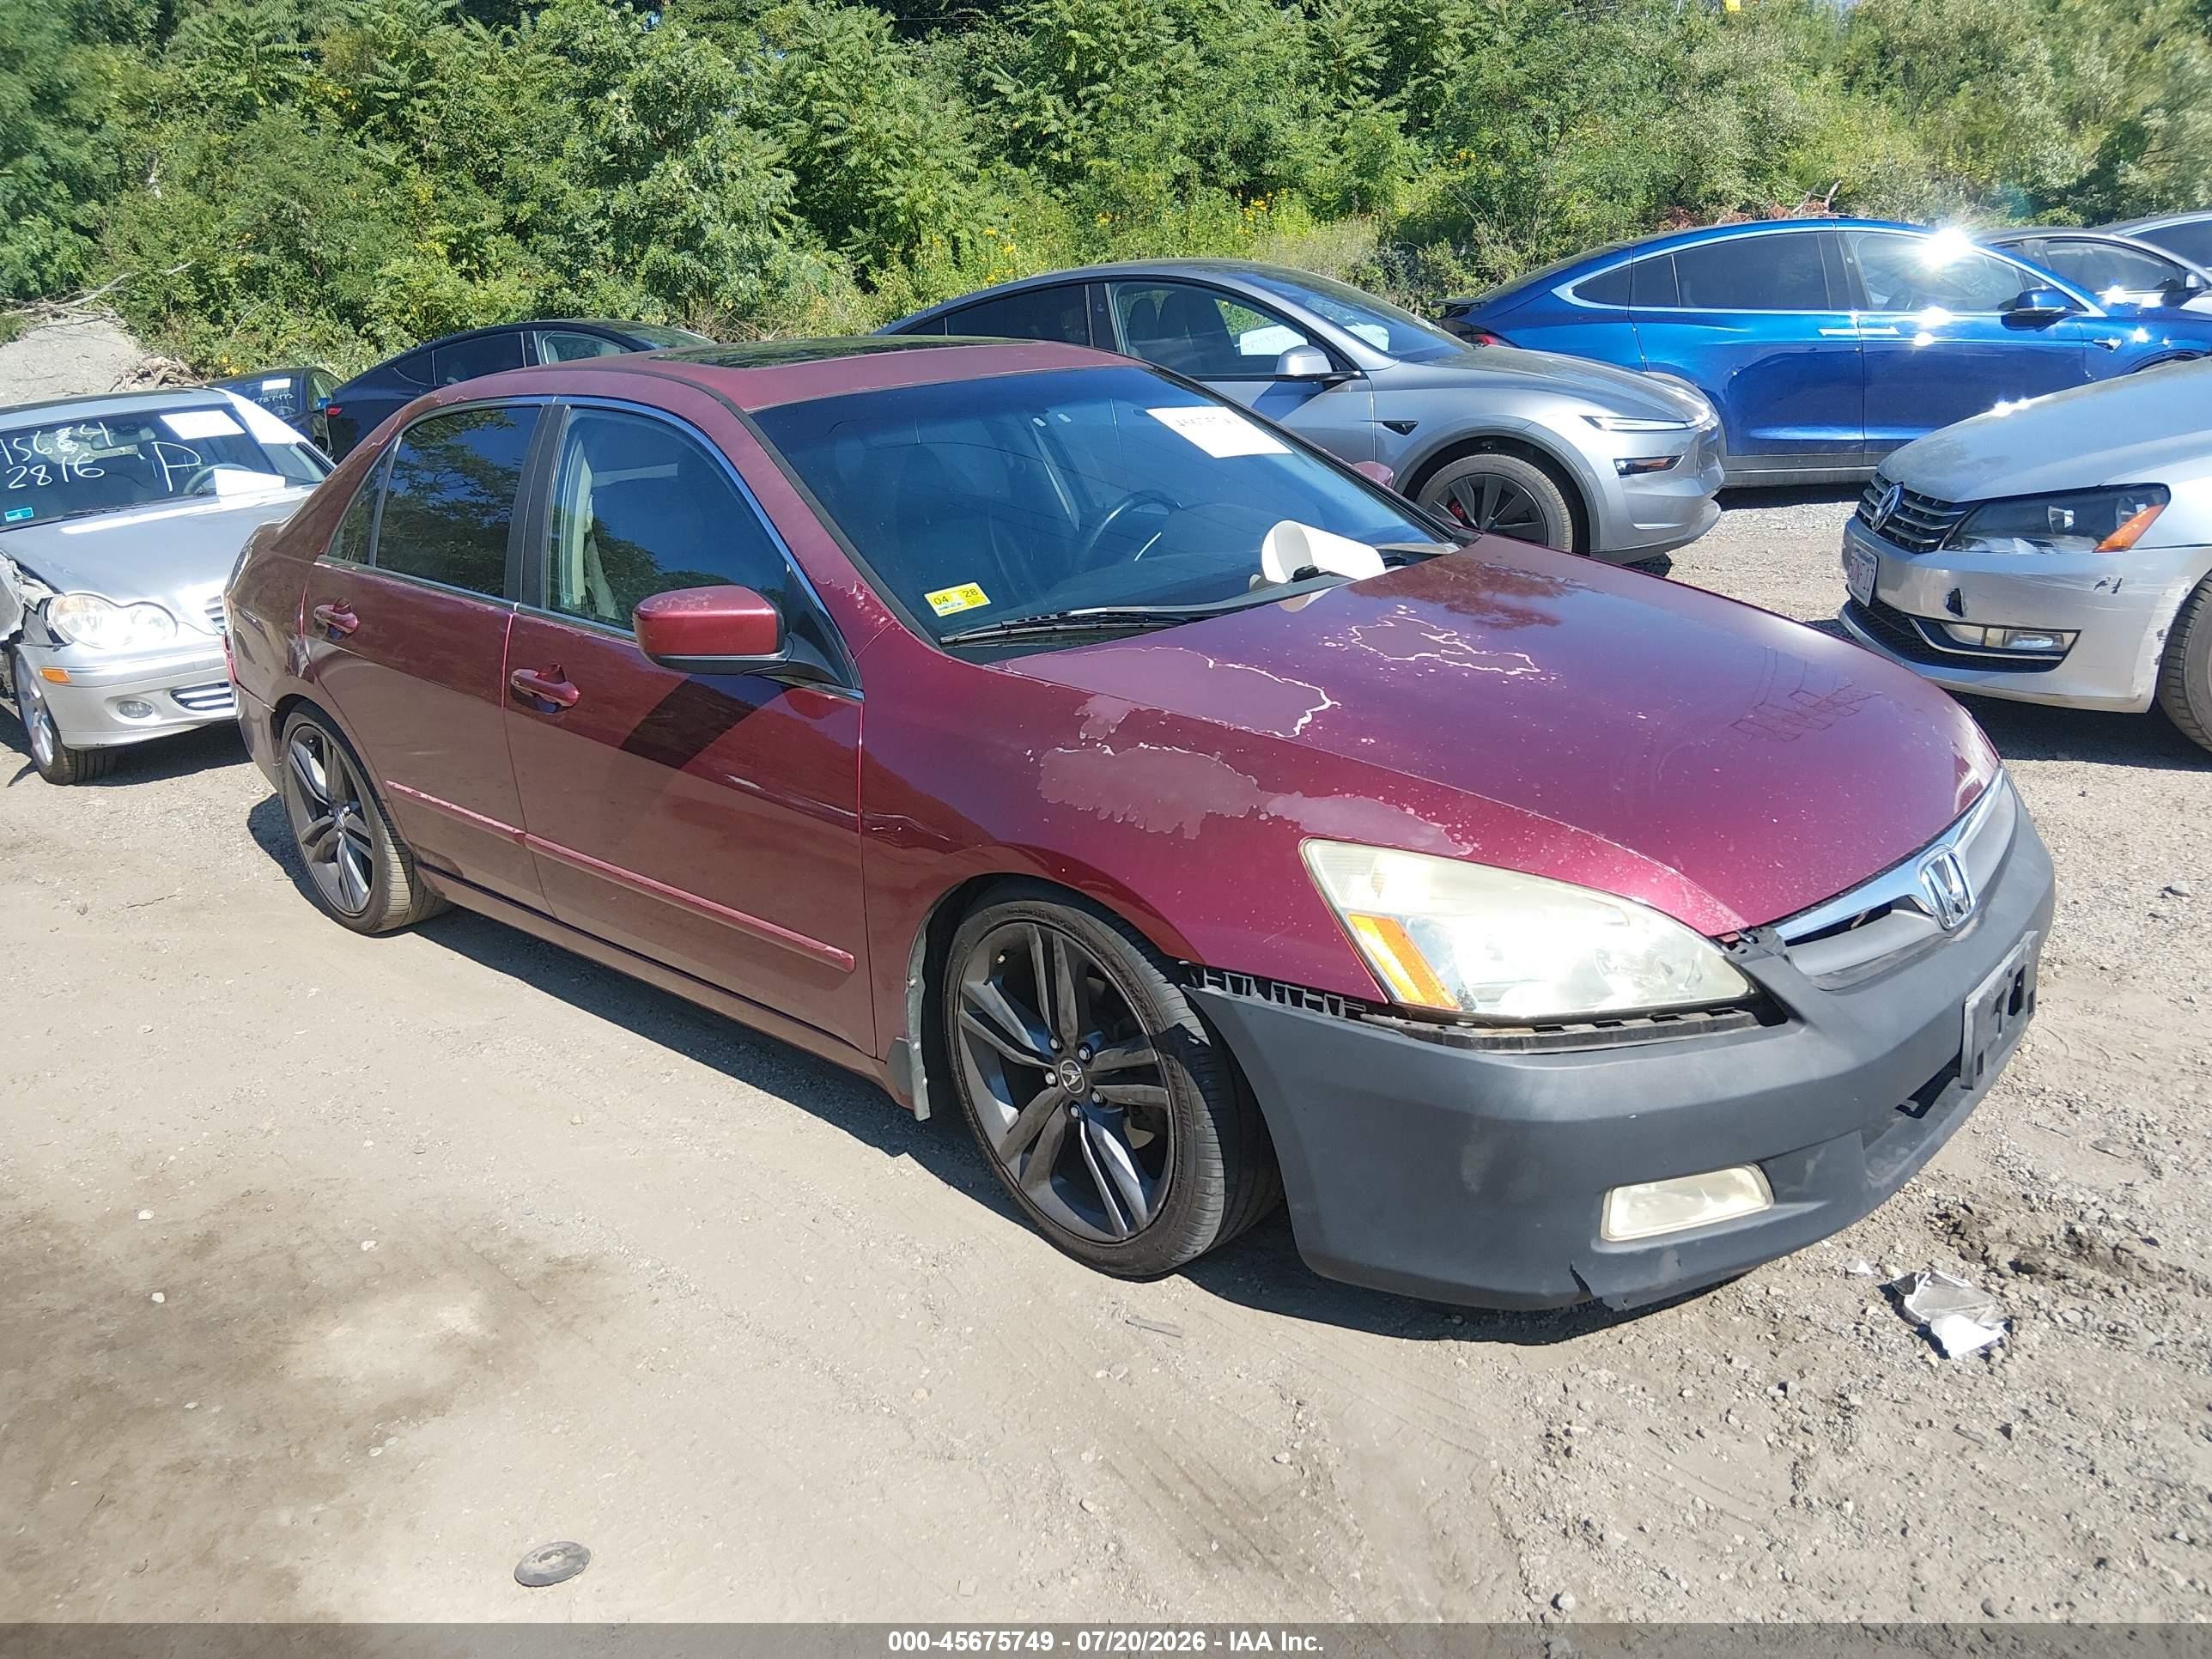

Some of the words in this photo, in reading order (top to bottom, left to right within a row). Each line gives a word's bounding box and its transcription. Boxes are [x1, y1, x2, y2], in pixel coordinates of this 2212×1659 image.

[5, 453, 105, 489] 2816
[933, 595, 949, 605] 04
[963, 588, 978, 598] 28
